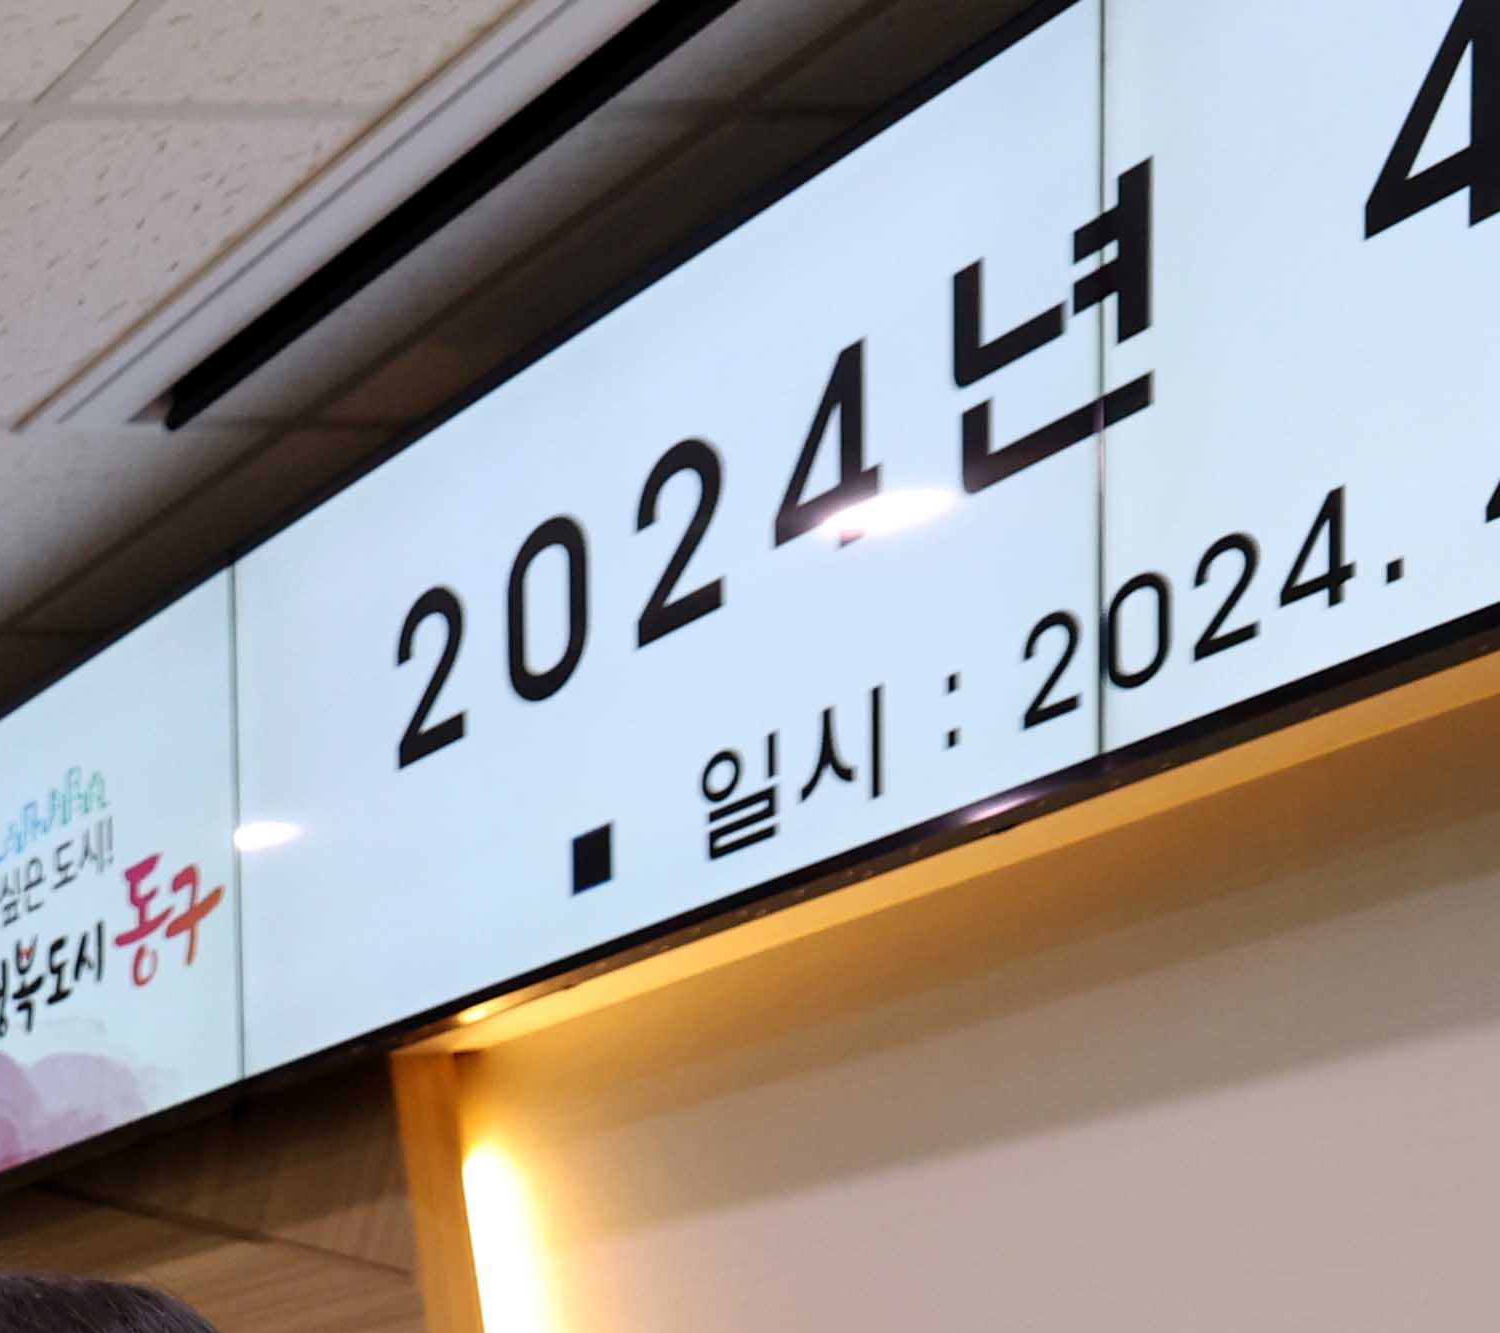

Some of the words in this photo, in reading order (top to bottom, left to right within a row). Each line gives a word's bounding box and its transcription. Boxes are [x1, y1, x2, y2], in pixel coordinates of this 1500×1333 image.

[396, 155, 1154, 770] 2024년
[700, 683, 884, 862] 일시
[1022, 483, 1405, 732] 2024.
[52, 815, 115, 890] 도시!
[113, 852, 226, 988] 동구
